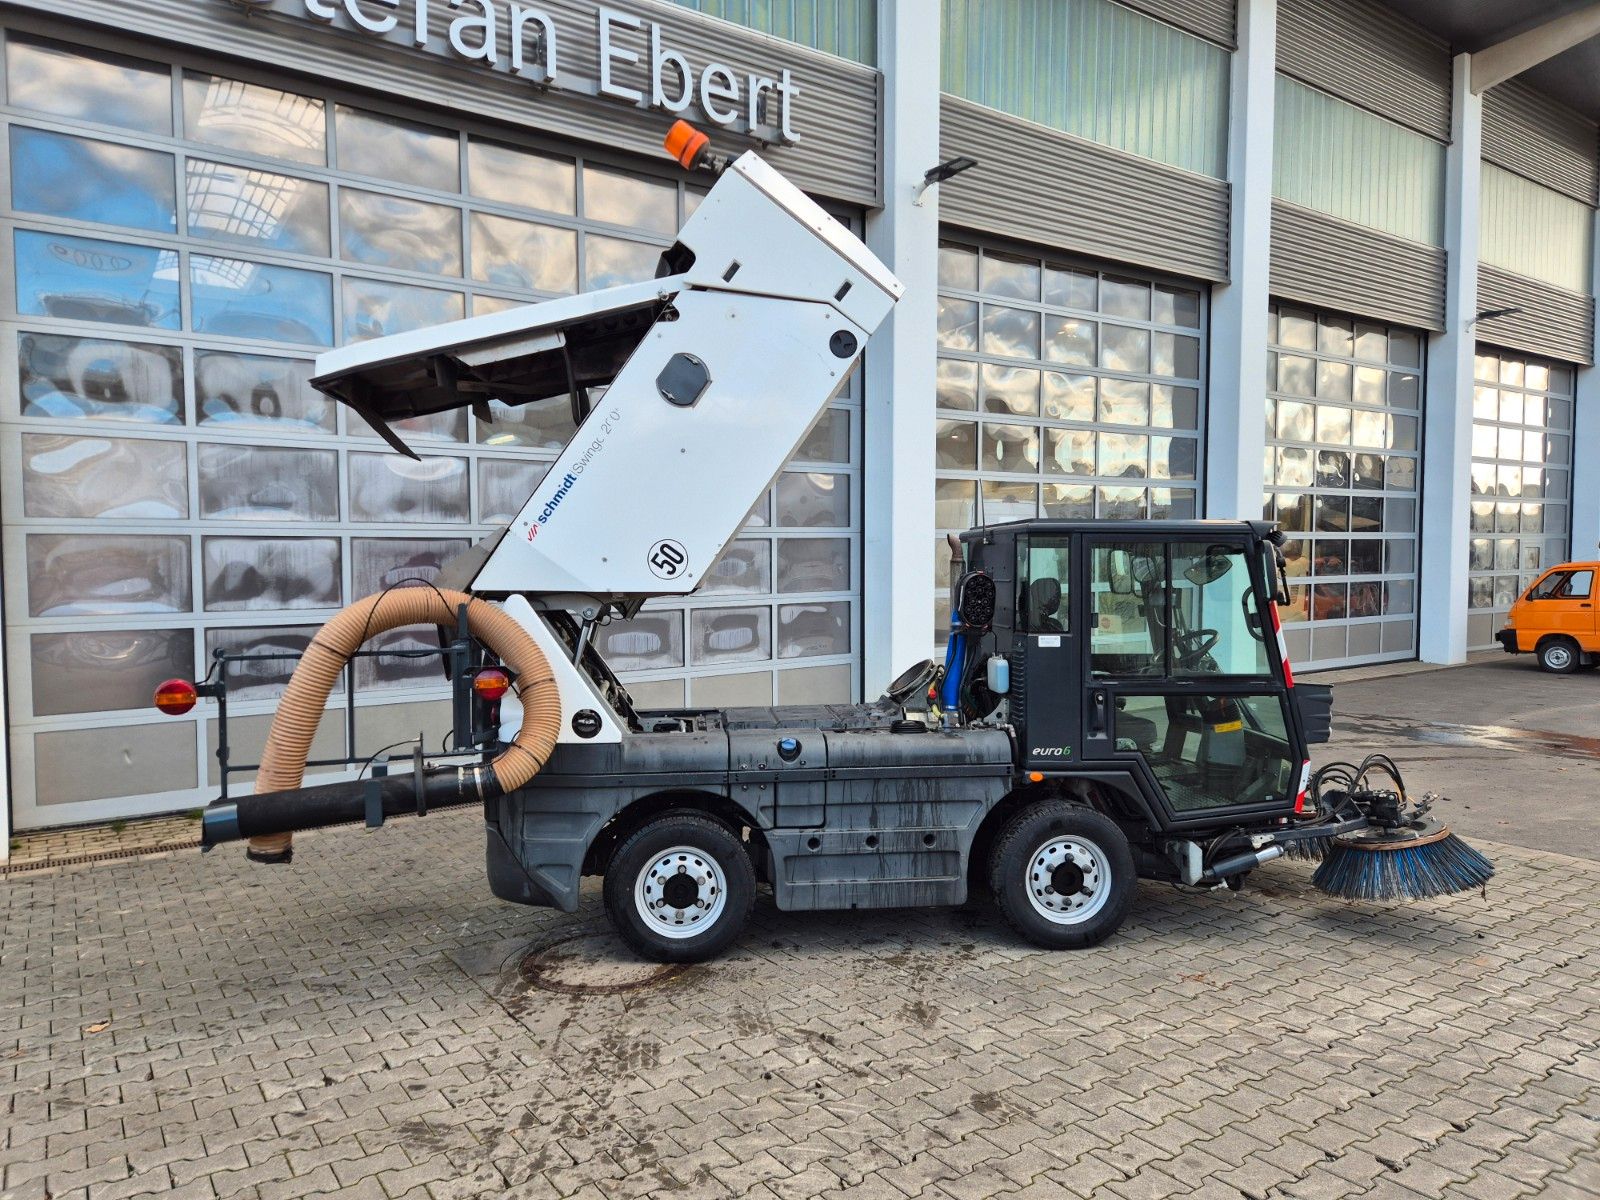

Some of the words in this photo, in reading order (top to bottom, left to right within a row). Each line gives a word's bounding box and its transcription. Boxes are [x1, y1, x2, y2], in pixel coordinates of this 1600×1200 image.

[599, 8, 801, 142] Ebert
[538, 473, 577, 524] schmidt
[650, 543, 685, 576] 50
[1032, 746, 1071, 756] euro6
